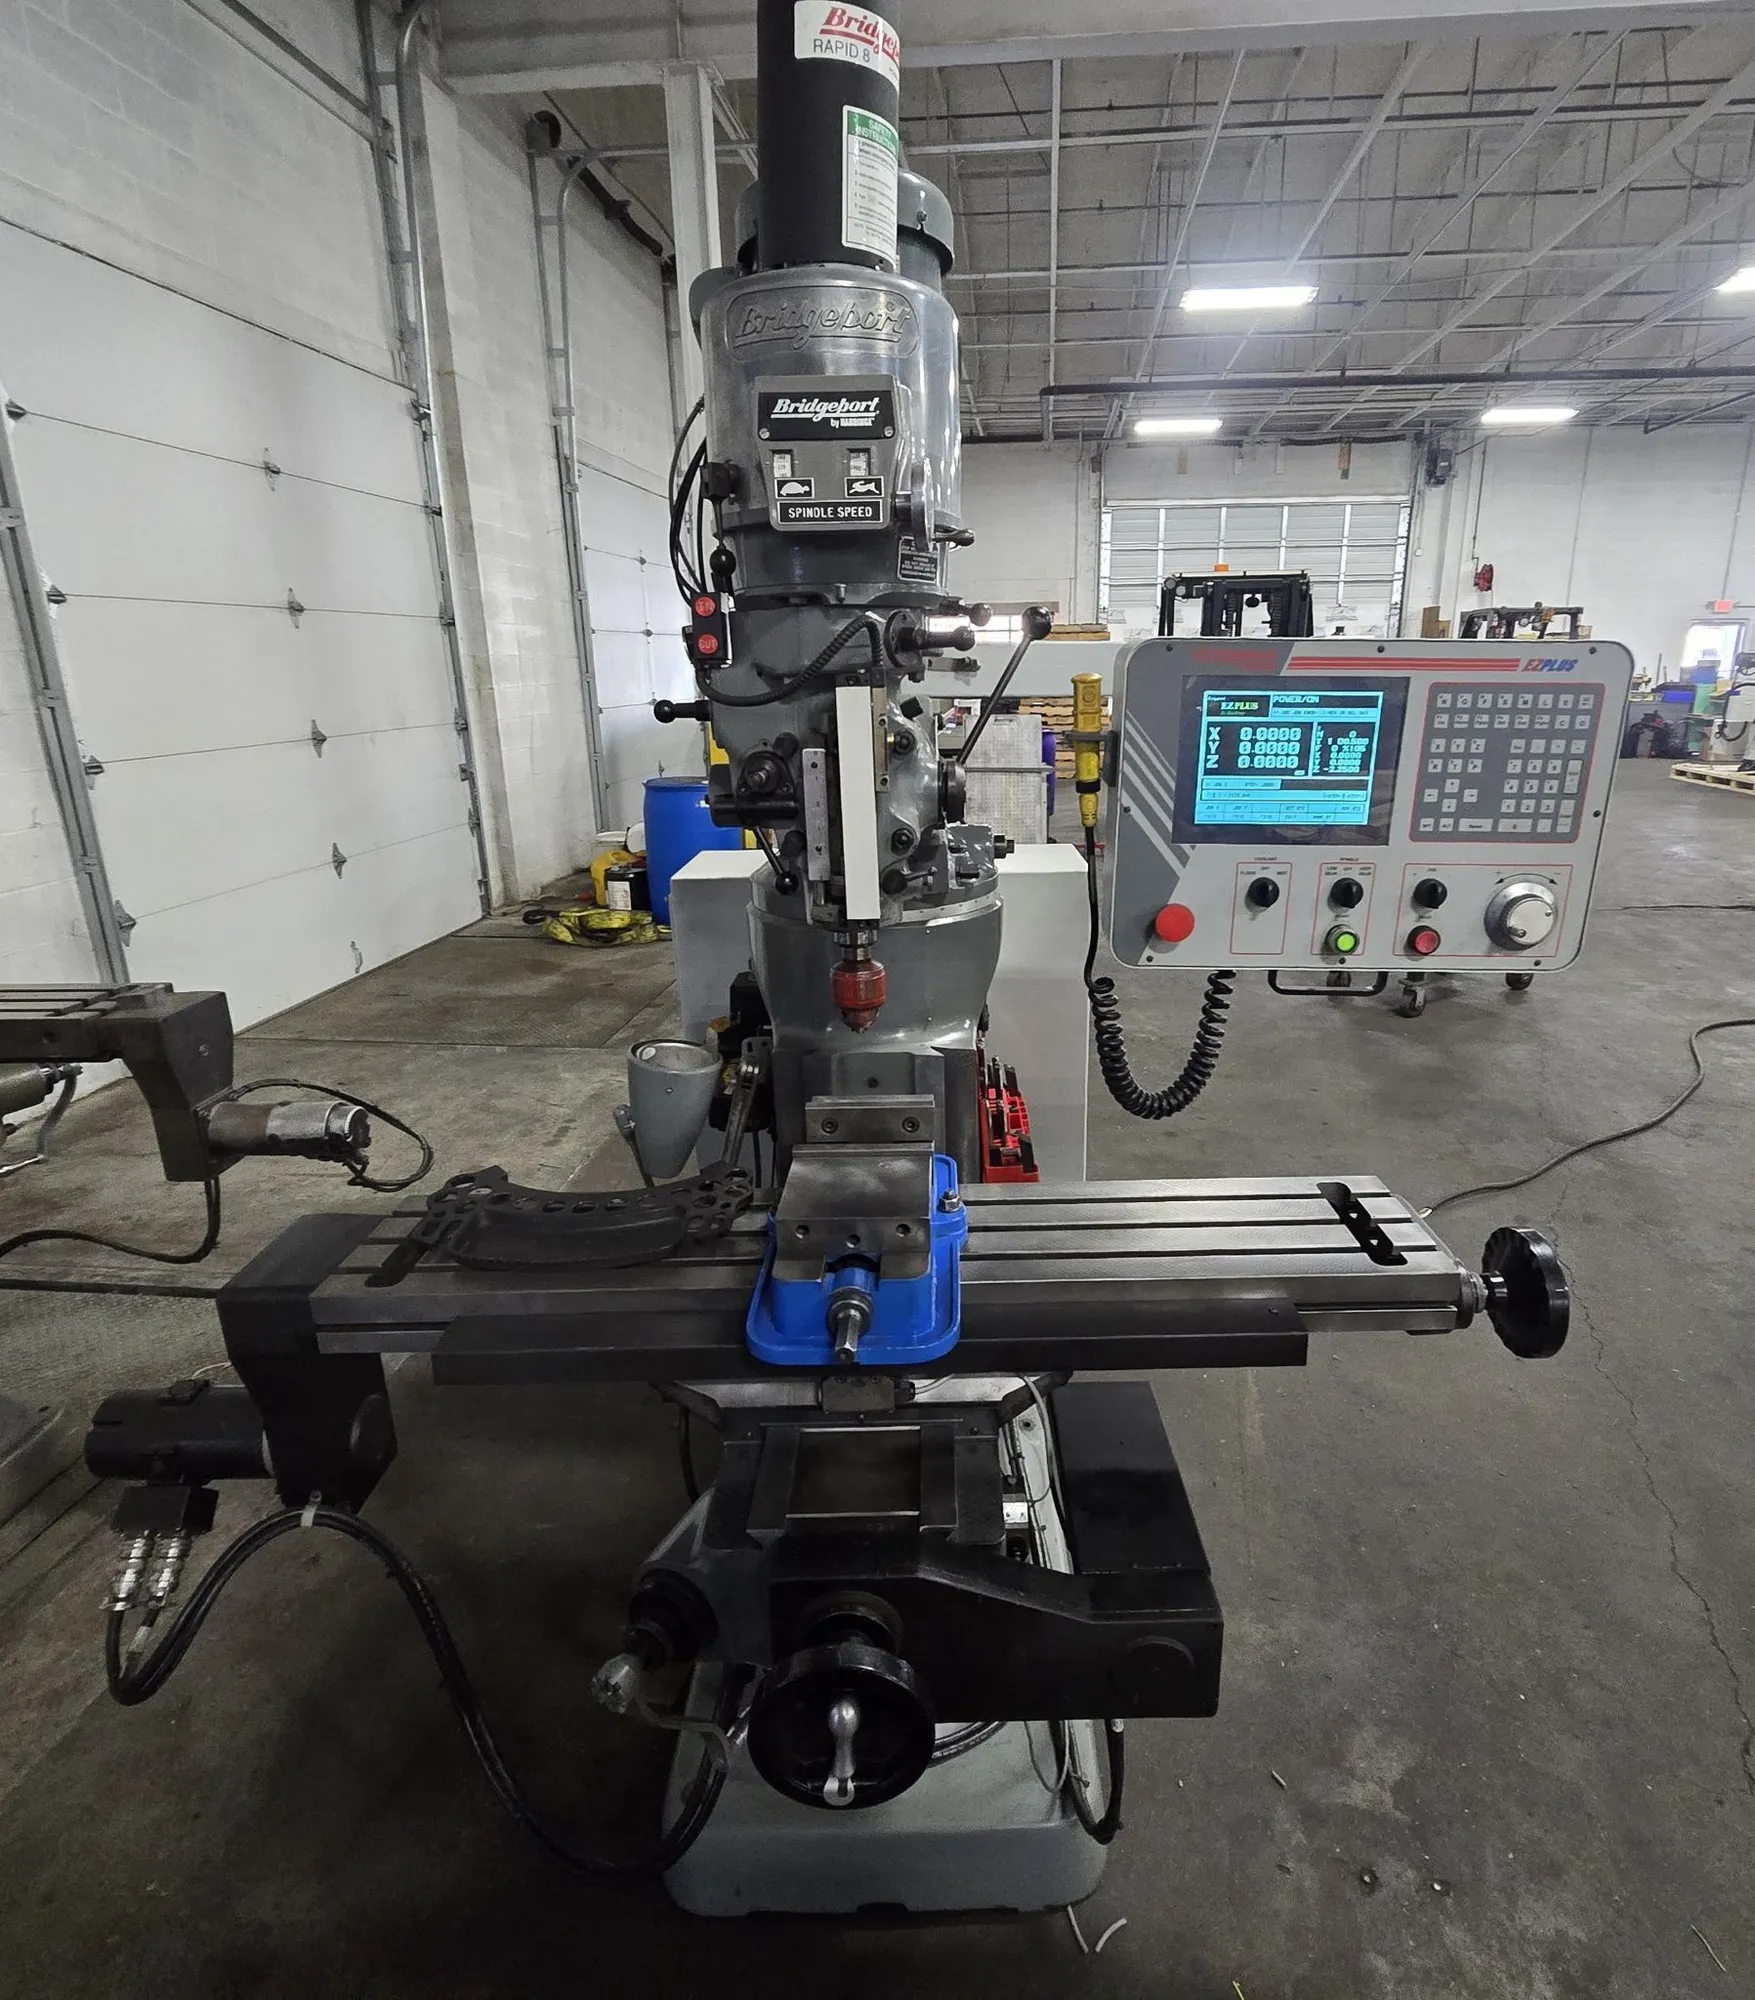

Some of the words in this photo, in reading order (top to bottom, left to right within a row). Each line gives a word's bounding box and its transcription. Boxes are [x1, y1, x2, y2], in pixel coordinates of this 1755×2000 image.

[813, 38, 859, 58] RAPID
[862, 48, 870, 62] 8
[772, 397, 880, 422] Bridgeport
[830, 418, 839, 429] by
[788, 507, 835, 519] SPINDLE
[837, 506, 873, 518] SPEED
[1521, 658, 1578, 673] EZPLUS
[1208, 726, 1221, 741] X
[1240, 727, 1302, 741] 0.0000
[1207, 741, 1220, 754] Y
[1239, 741, 1301, 755] 0.0000
[1206, 754, 1220, 769] Z
[1237, 755, 1299, 769] 0.0000
